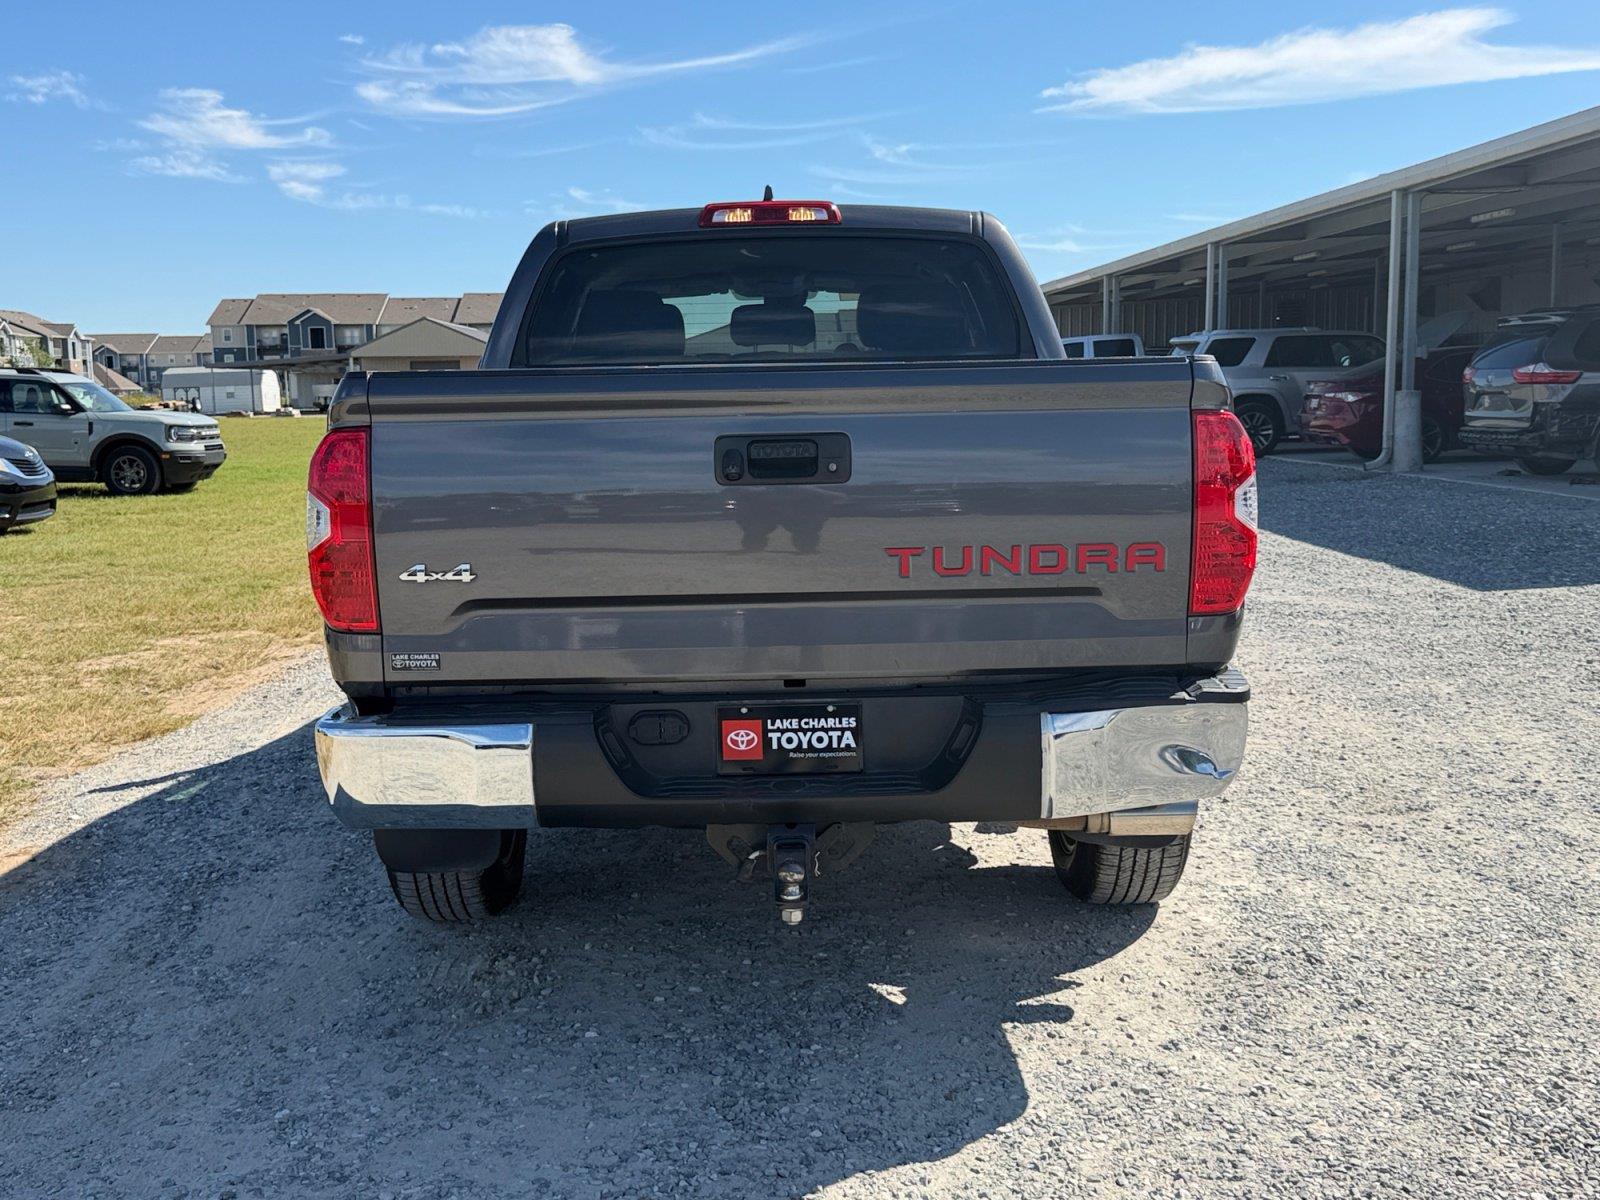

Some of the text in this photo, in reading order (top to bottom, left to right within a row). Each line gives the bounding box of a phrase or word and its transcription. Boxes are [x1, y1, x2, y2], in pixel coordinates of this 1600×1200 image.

[752, 444, 813, 457] TOYOTA
[884, 541, 1166, 577] TUNDRA
[399, 563, 477, 582] 4x4
[767, 717, 857, 729] LAKE CHARLES
[768, 731, 857, 750] TOYOTA
